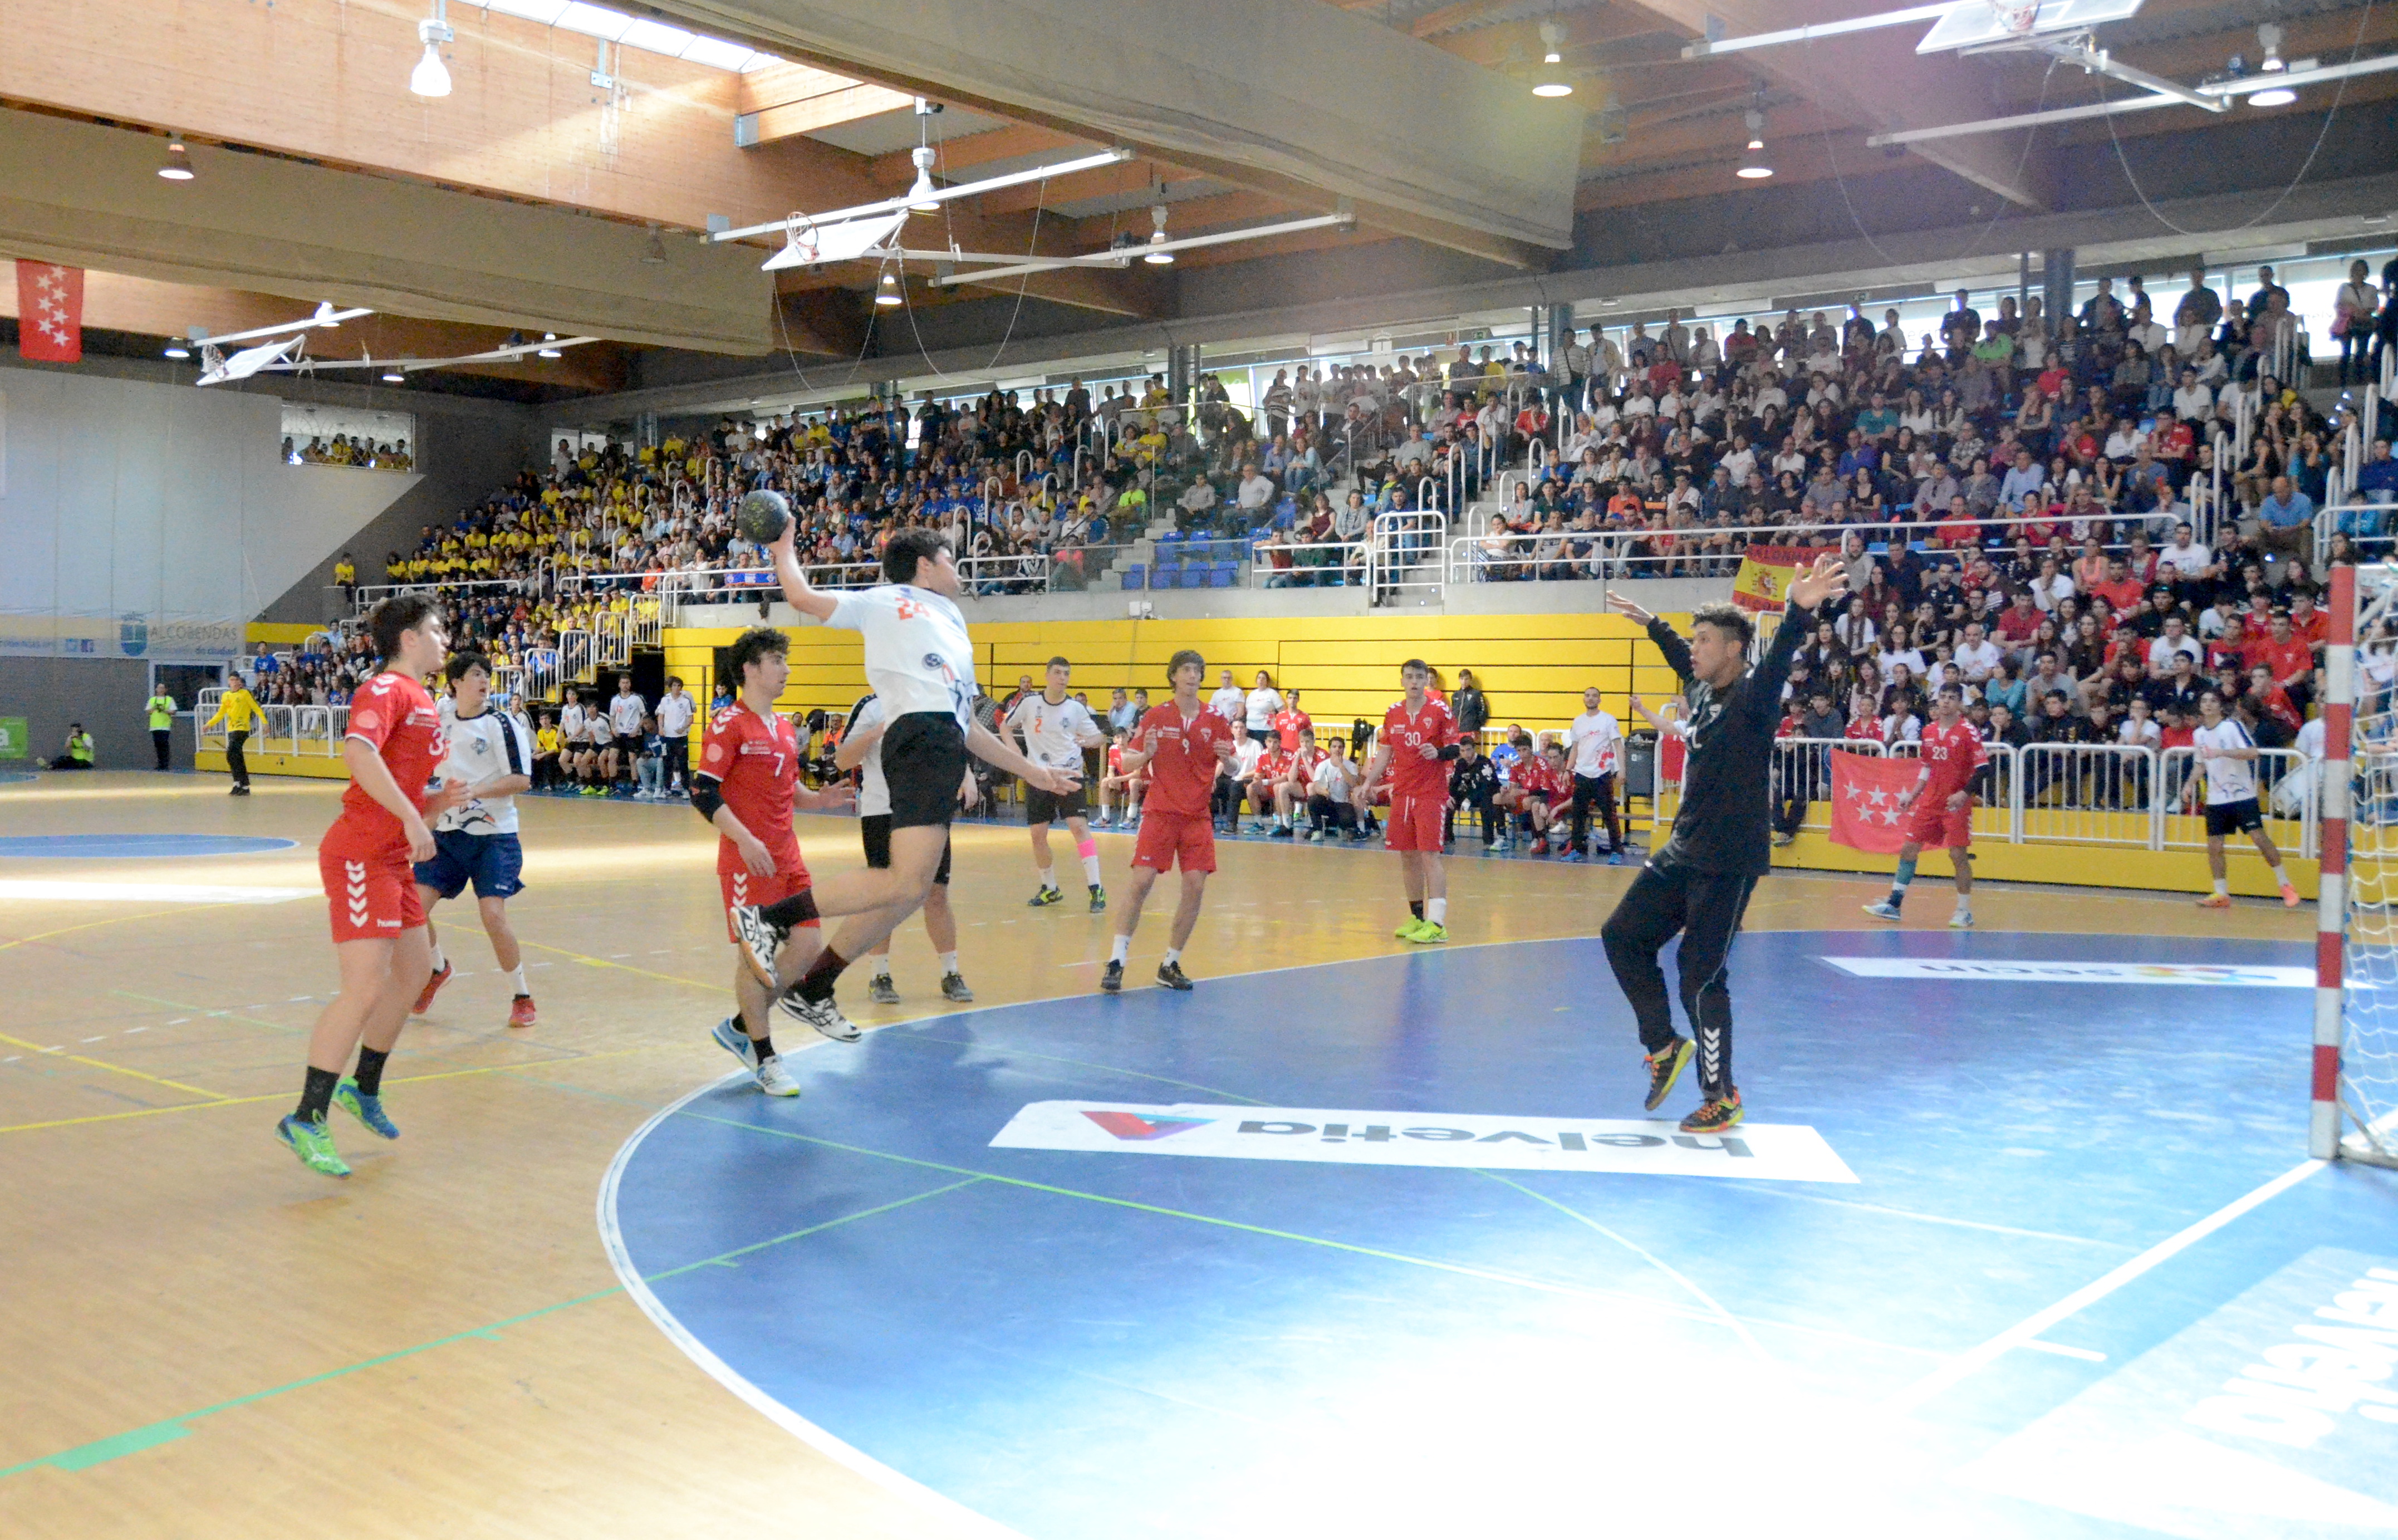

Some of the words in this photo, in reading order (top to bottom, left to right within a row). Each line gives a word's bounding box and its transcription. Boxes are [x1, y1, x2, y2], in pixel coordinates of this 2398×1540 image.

[895, 597, 931, 620] 24
[149, 624, 238, 640] ALCOBENDAS
[1035, 718, 1042, 733] 2
[429, 727, 444, 756] 3
[1182, 738, 1190, 755] 9
[1404, 731, 1420, 747] 30
[1931, 746, 1948, 761] 23
[773, 752, 786, 777] 7
[1918, 964, 2123, 977] secin
[1237, 1118, 1754, 1158] helvetia
